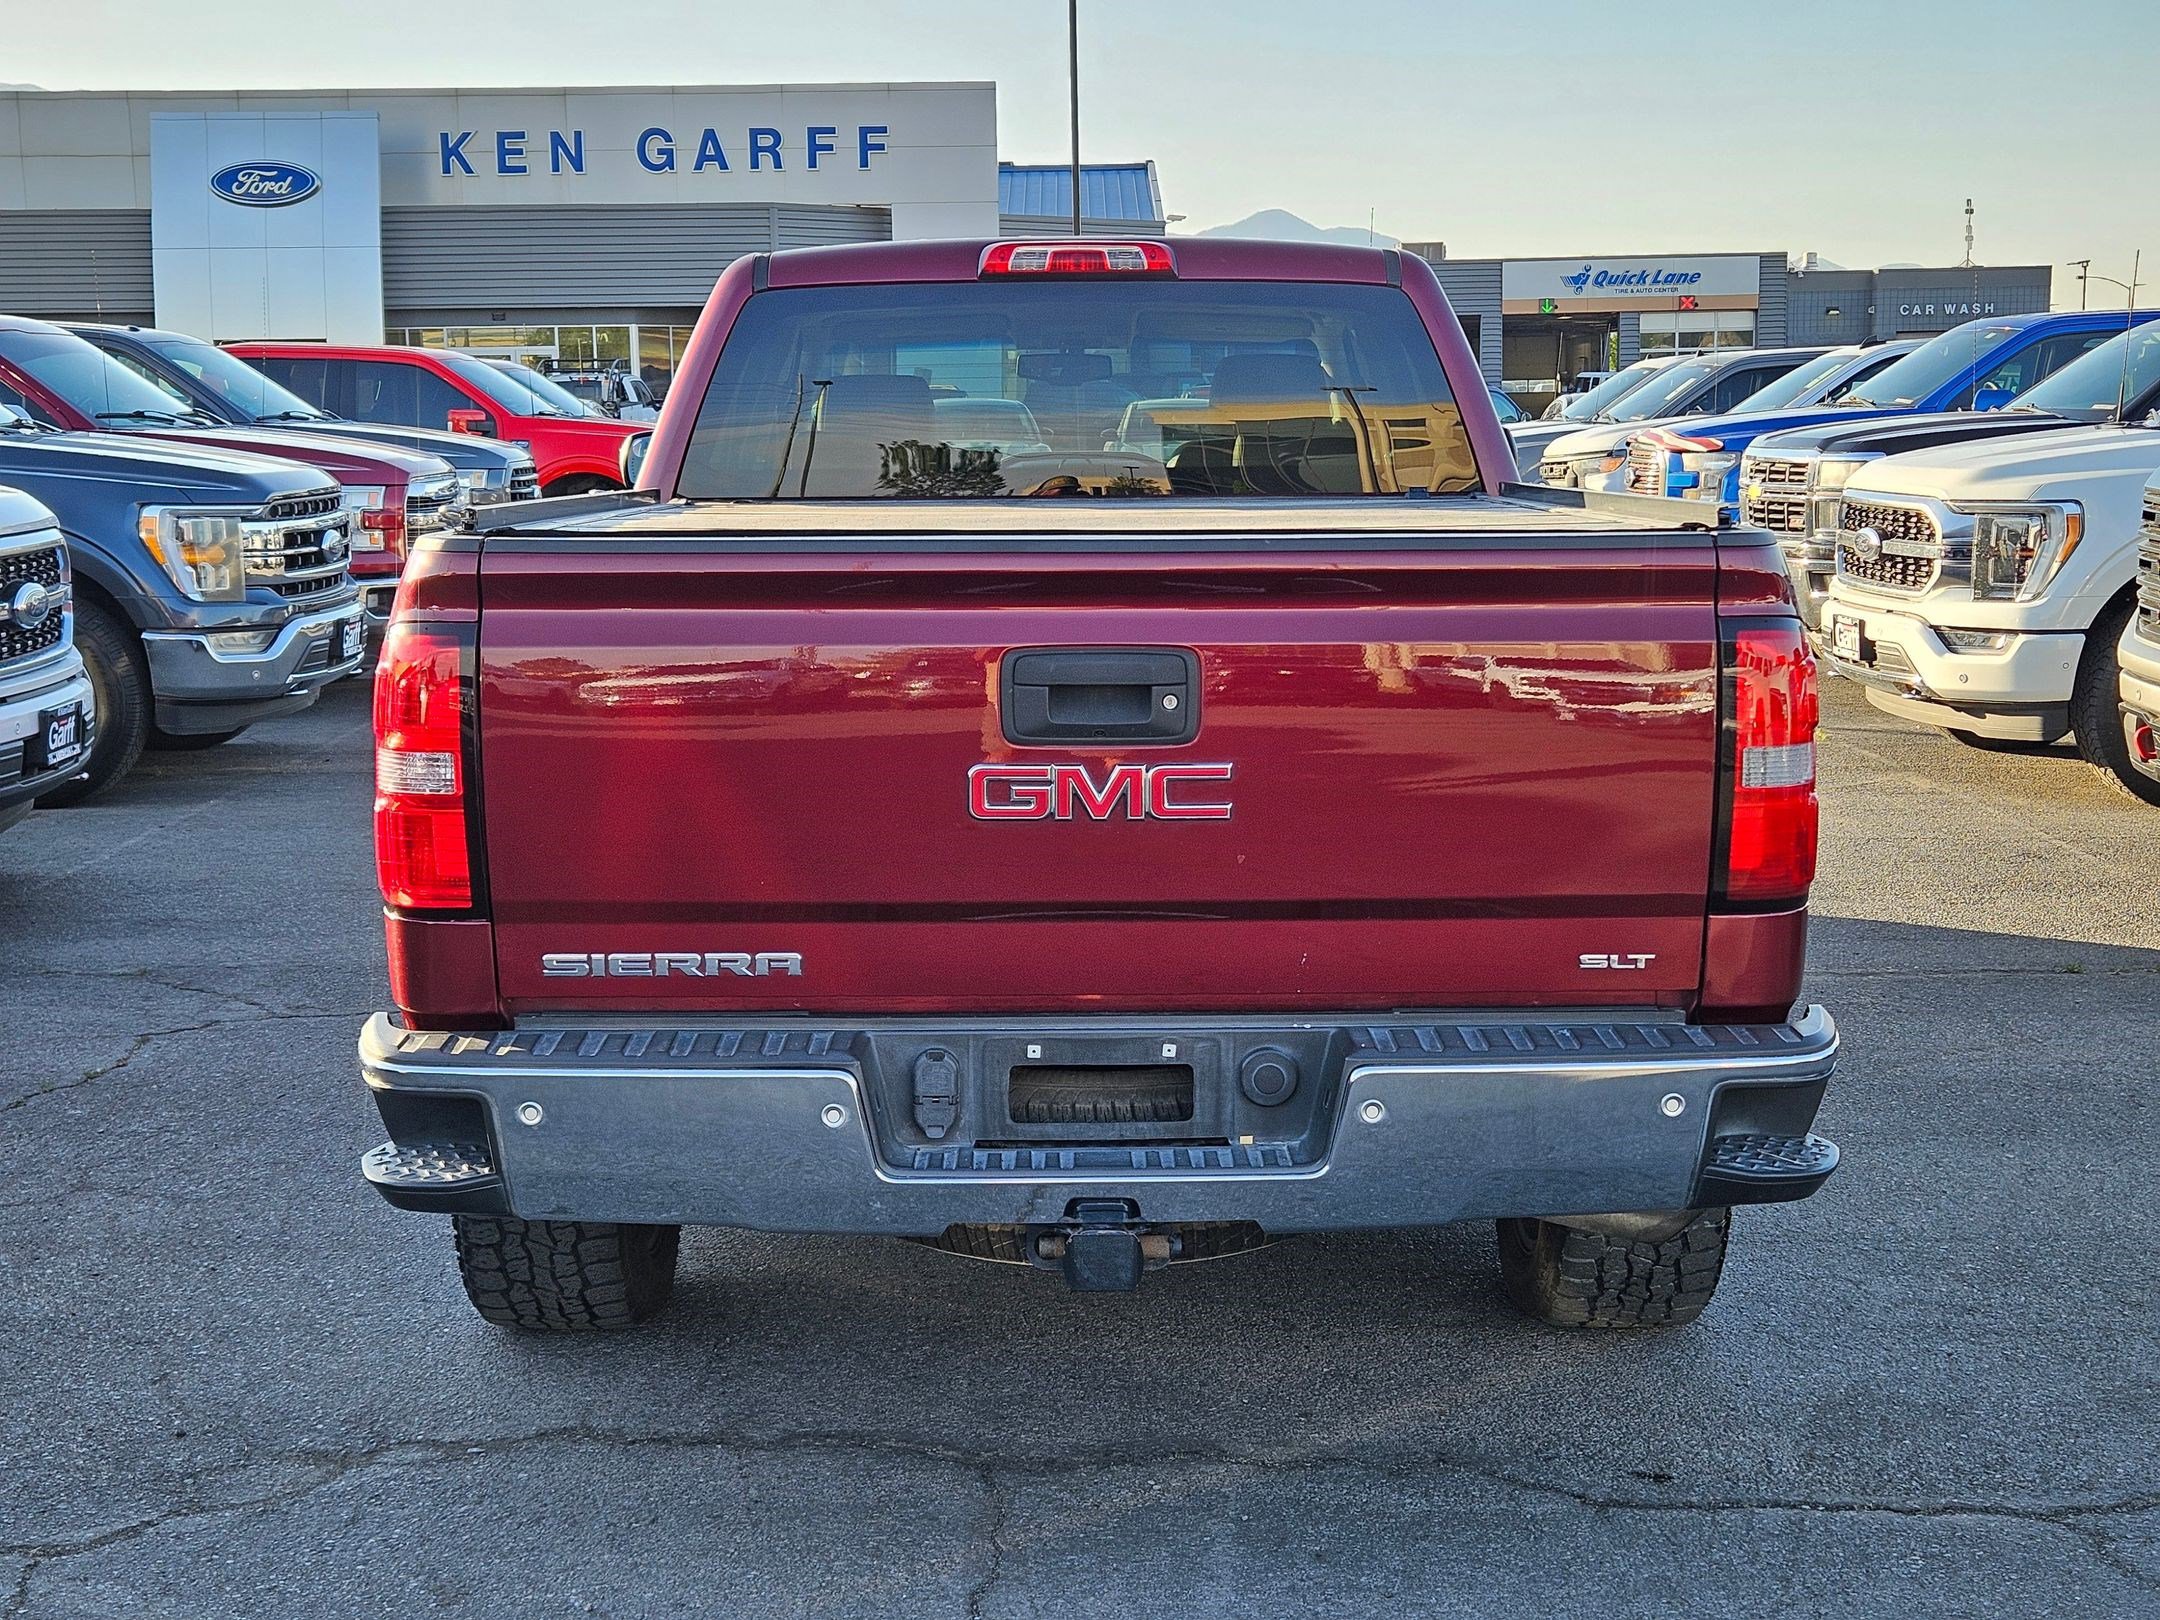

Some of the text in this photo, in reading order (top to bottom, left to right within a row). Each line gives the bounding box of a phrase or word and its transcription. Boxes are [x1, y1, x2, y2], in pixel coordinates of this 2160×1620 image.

[438, 124, 891, 177] KEN GARFF
[231, 169, 293, 195] Ford
[1592, 269, 1702, 288] Quick Lane
[1899, 302, 1994, 316] CAR WASH
[968, 763, 1233, 820] GMC
[542, 952, 803, 977] SIERRA
[1579, 953, 1656, 969] SLT
